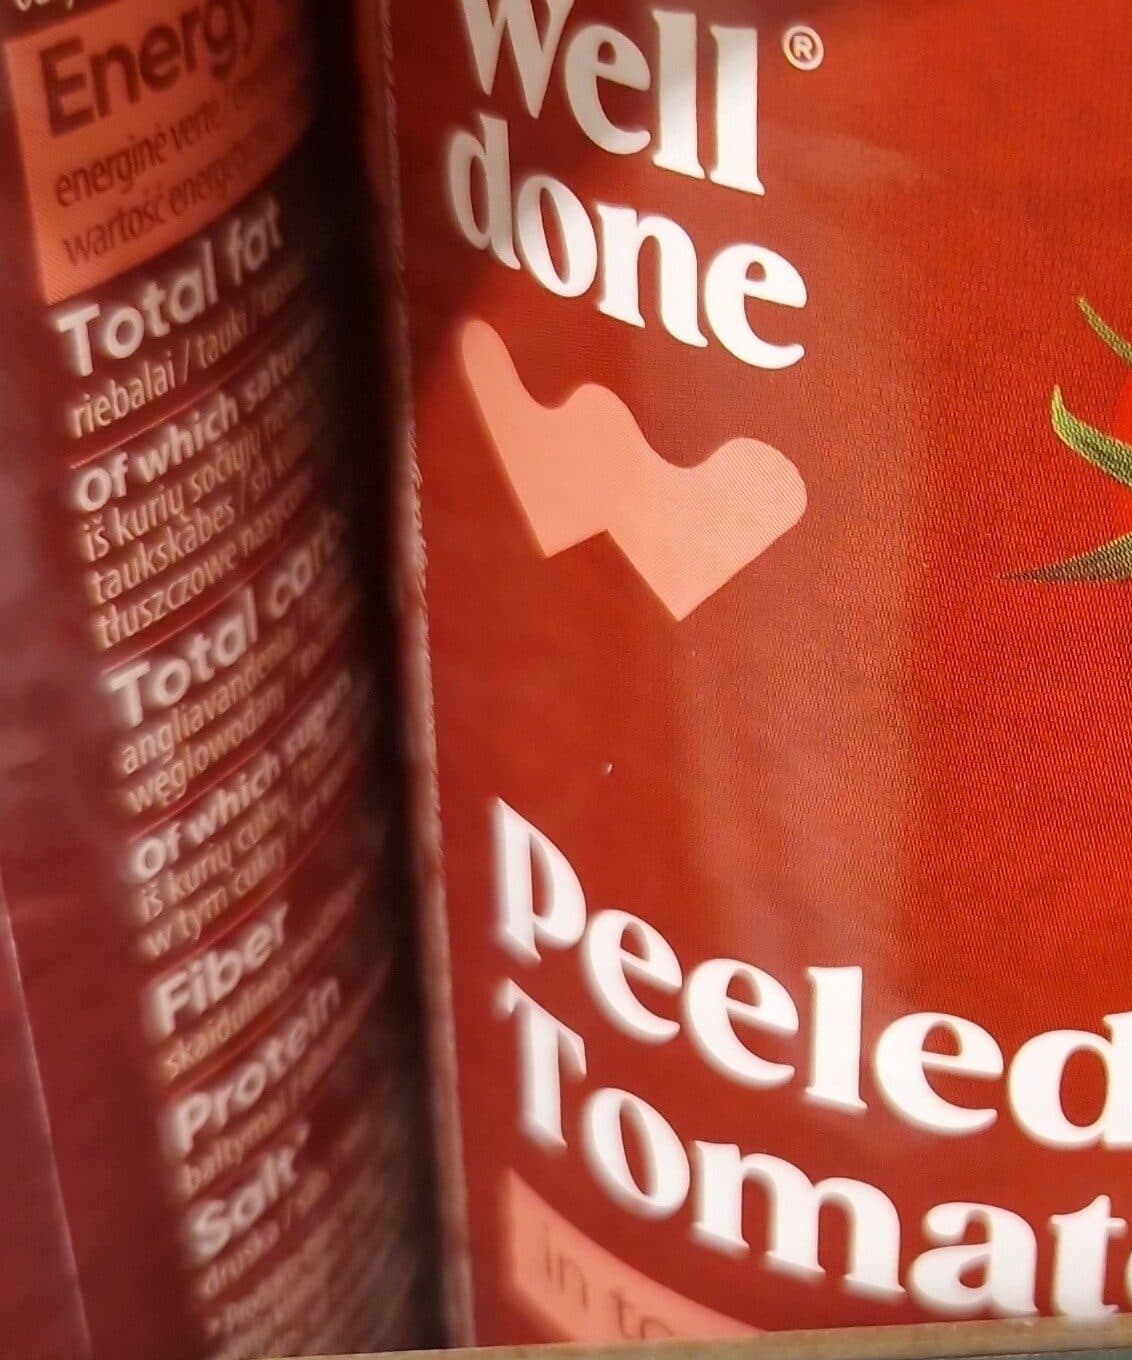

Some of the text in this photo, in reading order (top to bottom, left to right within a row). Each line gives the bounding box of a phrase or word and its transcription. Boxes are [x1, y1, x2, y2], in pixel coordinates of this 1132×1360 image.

[55, 239, 217, 378] Total
[226, 195, 283, 287] fat
[448, 112, 808, 370] done
[70, 353, 176, 439] riebalai
[76, 451, 129, 513] Of
[137, 390, 239, 483] which
[107, 586, 258, 727] Total
[133, 821, 183, 879] Of
[190, 751, 280, 843] which
[153, 902, 289, 1036] Fiber
[170, 976, 342, 1156] Protein
